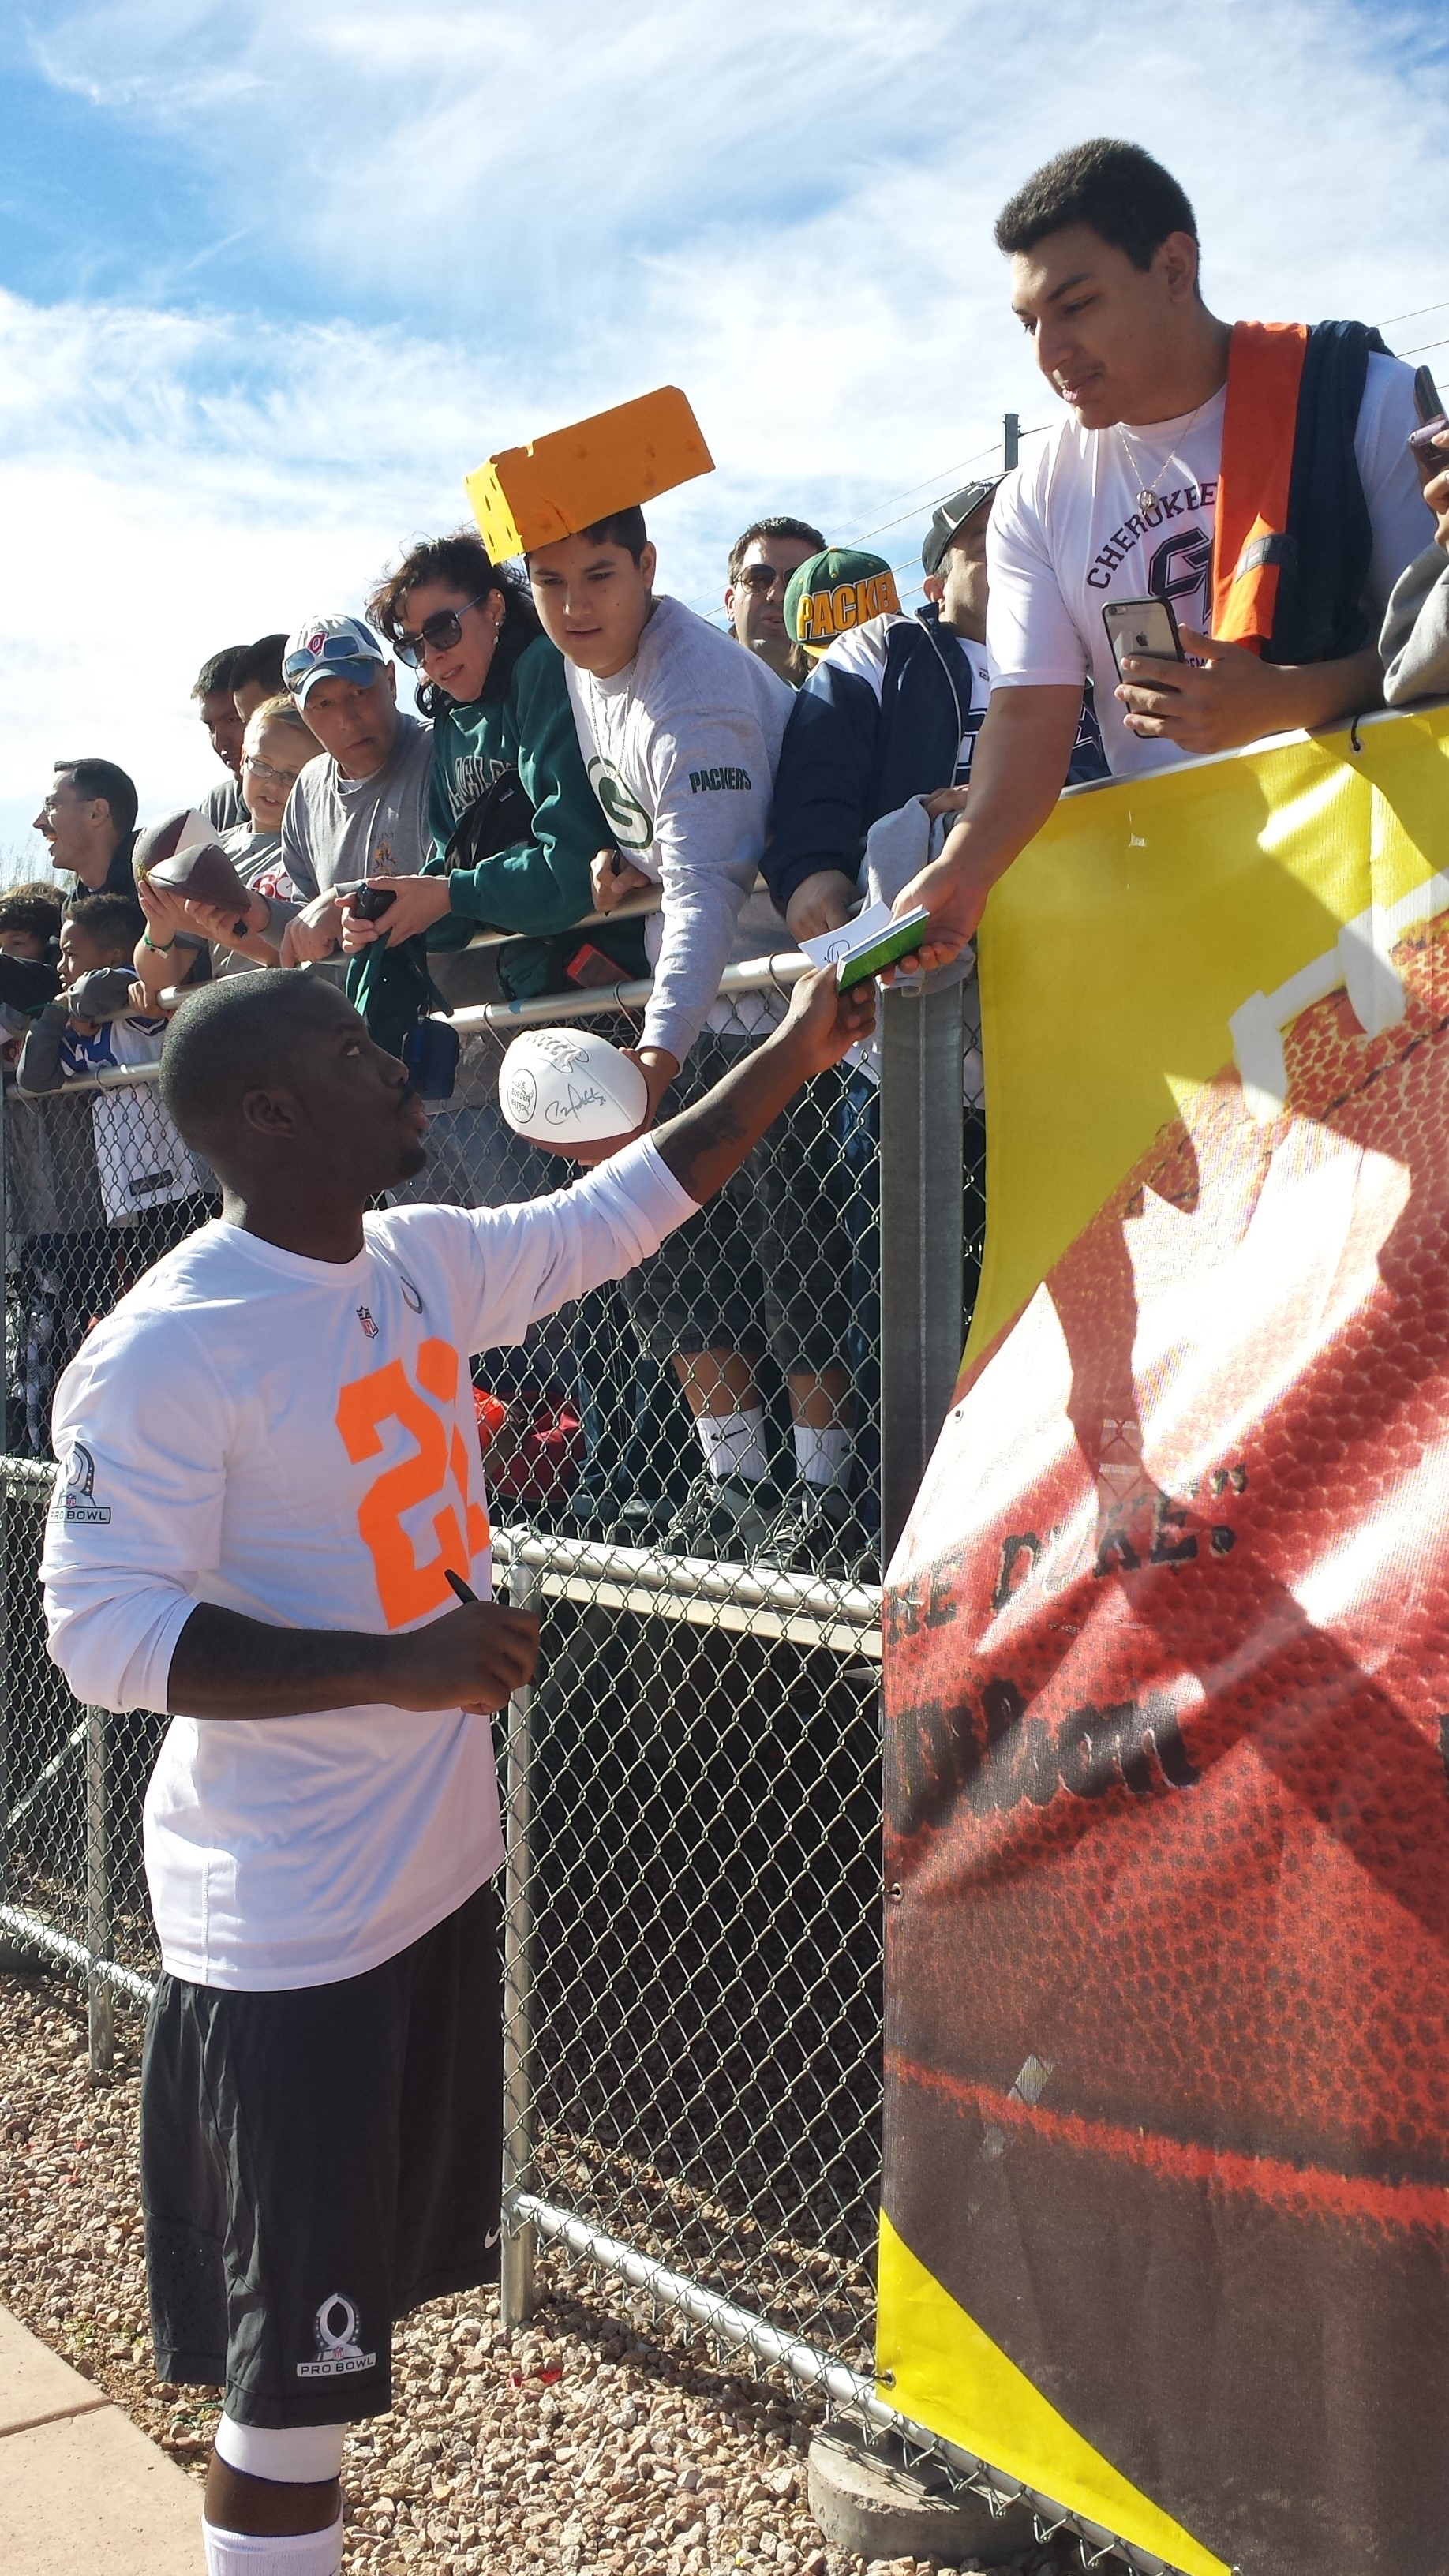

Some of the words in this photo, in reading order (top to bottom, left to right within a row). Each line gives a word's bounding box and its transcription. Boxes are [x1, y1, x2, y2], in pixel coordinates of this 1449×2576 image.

[1087, 481, 1218, 590] CHEROKEE
[796, 570, 900, 641] PACKE
[689, 767, 752, 794] PACKERS
[511, 1088, 530, 1103] BORDER
[50, 1511, 64, 1520] PRO
[66, 1511, 107, 1521] BOWL
[301, 2364, 331, 2375] PRO
[335, 2357, 373, 2372] BOWL
